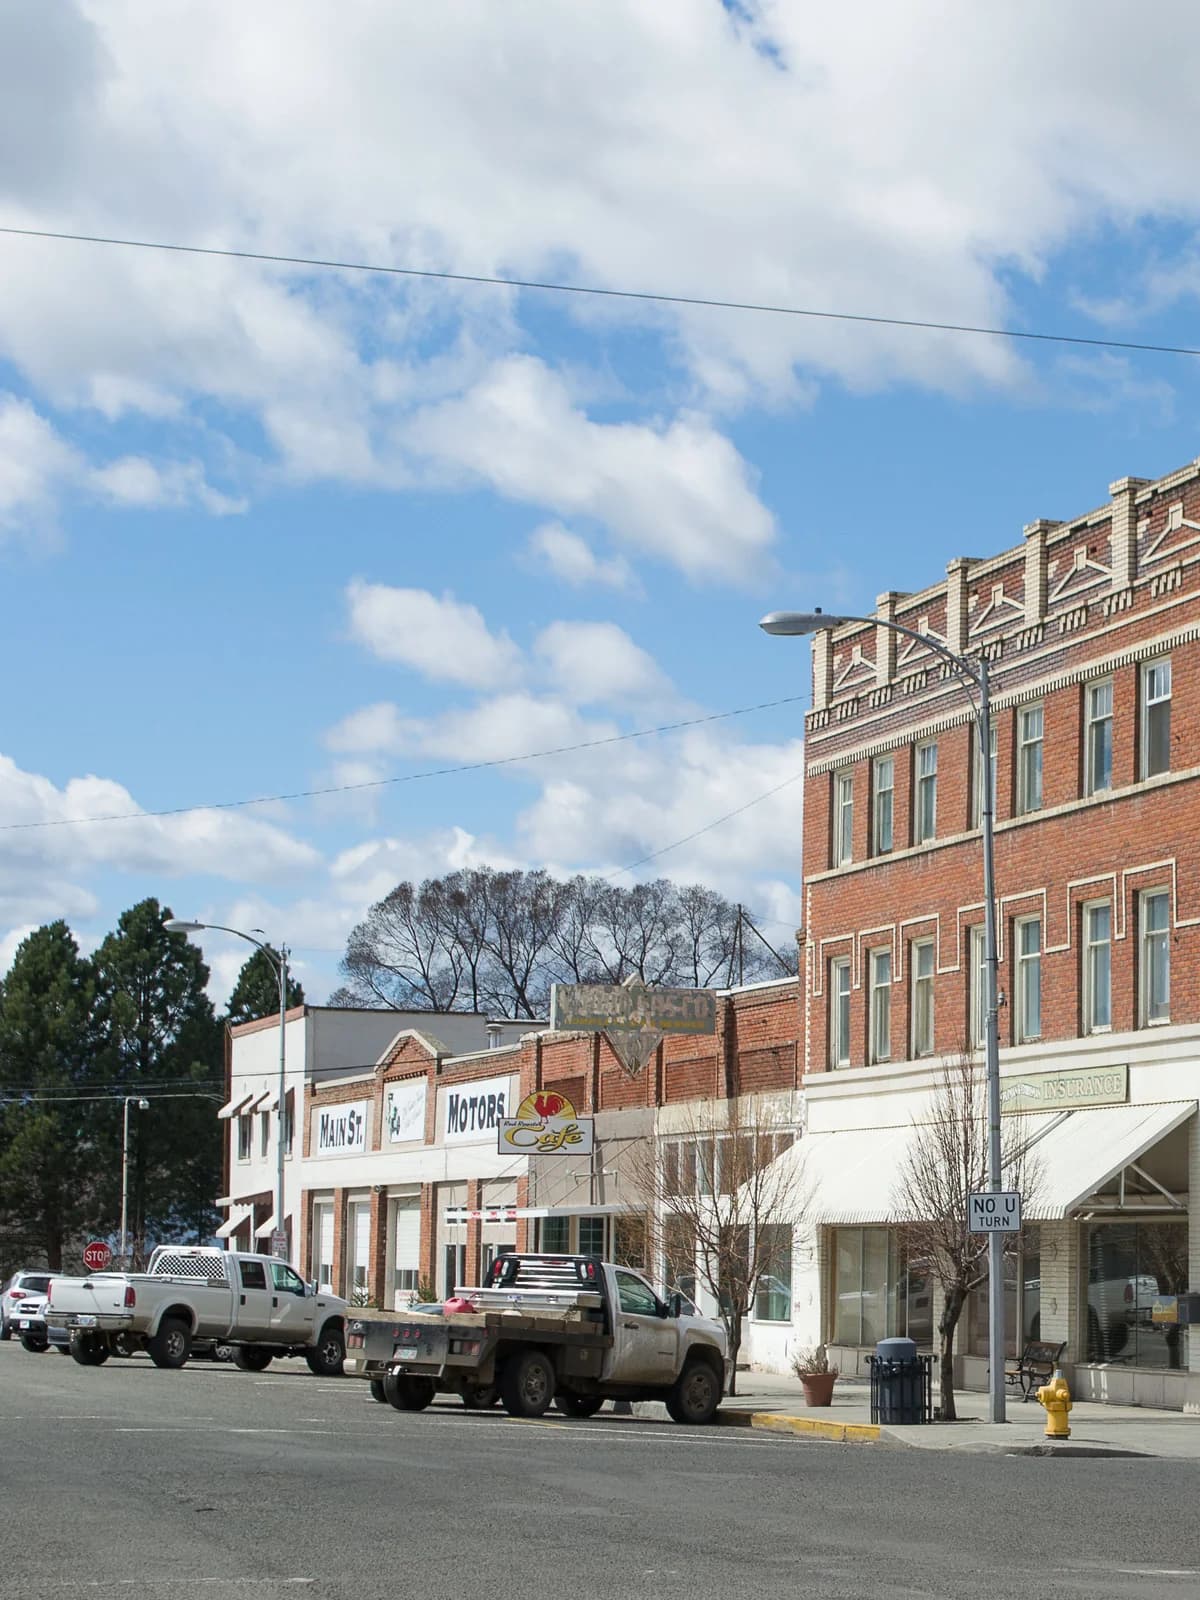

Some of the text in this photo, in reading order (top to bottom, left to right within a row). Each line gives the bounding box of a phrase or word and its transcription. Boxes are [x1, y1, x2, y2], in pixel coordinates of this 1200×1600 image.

[1043, 1073, 1121, 1100] INSURANCE
[447, 1092, 505, 1134] MOTORS
[319, 1110, 362, 1148] MAIN ST.
[974, 1198, 1016, 1213] NO U
[979, 1216, 1010, 1227] TURN
[85, 1250, 110, 1261] STOP
